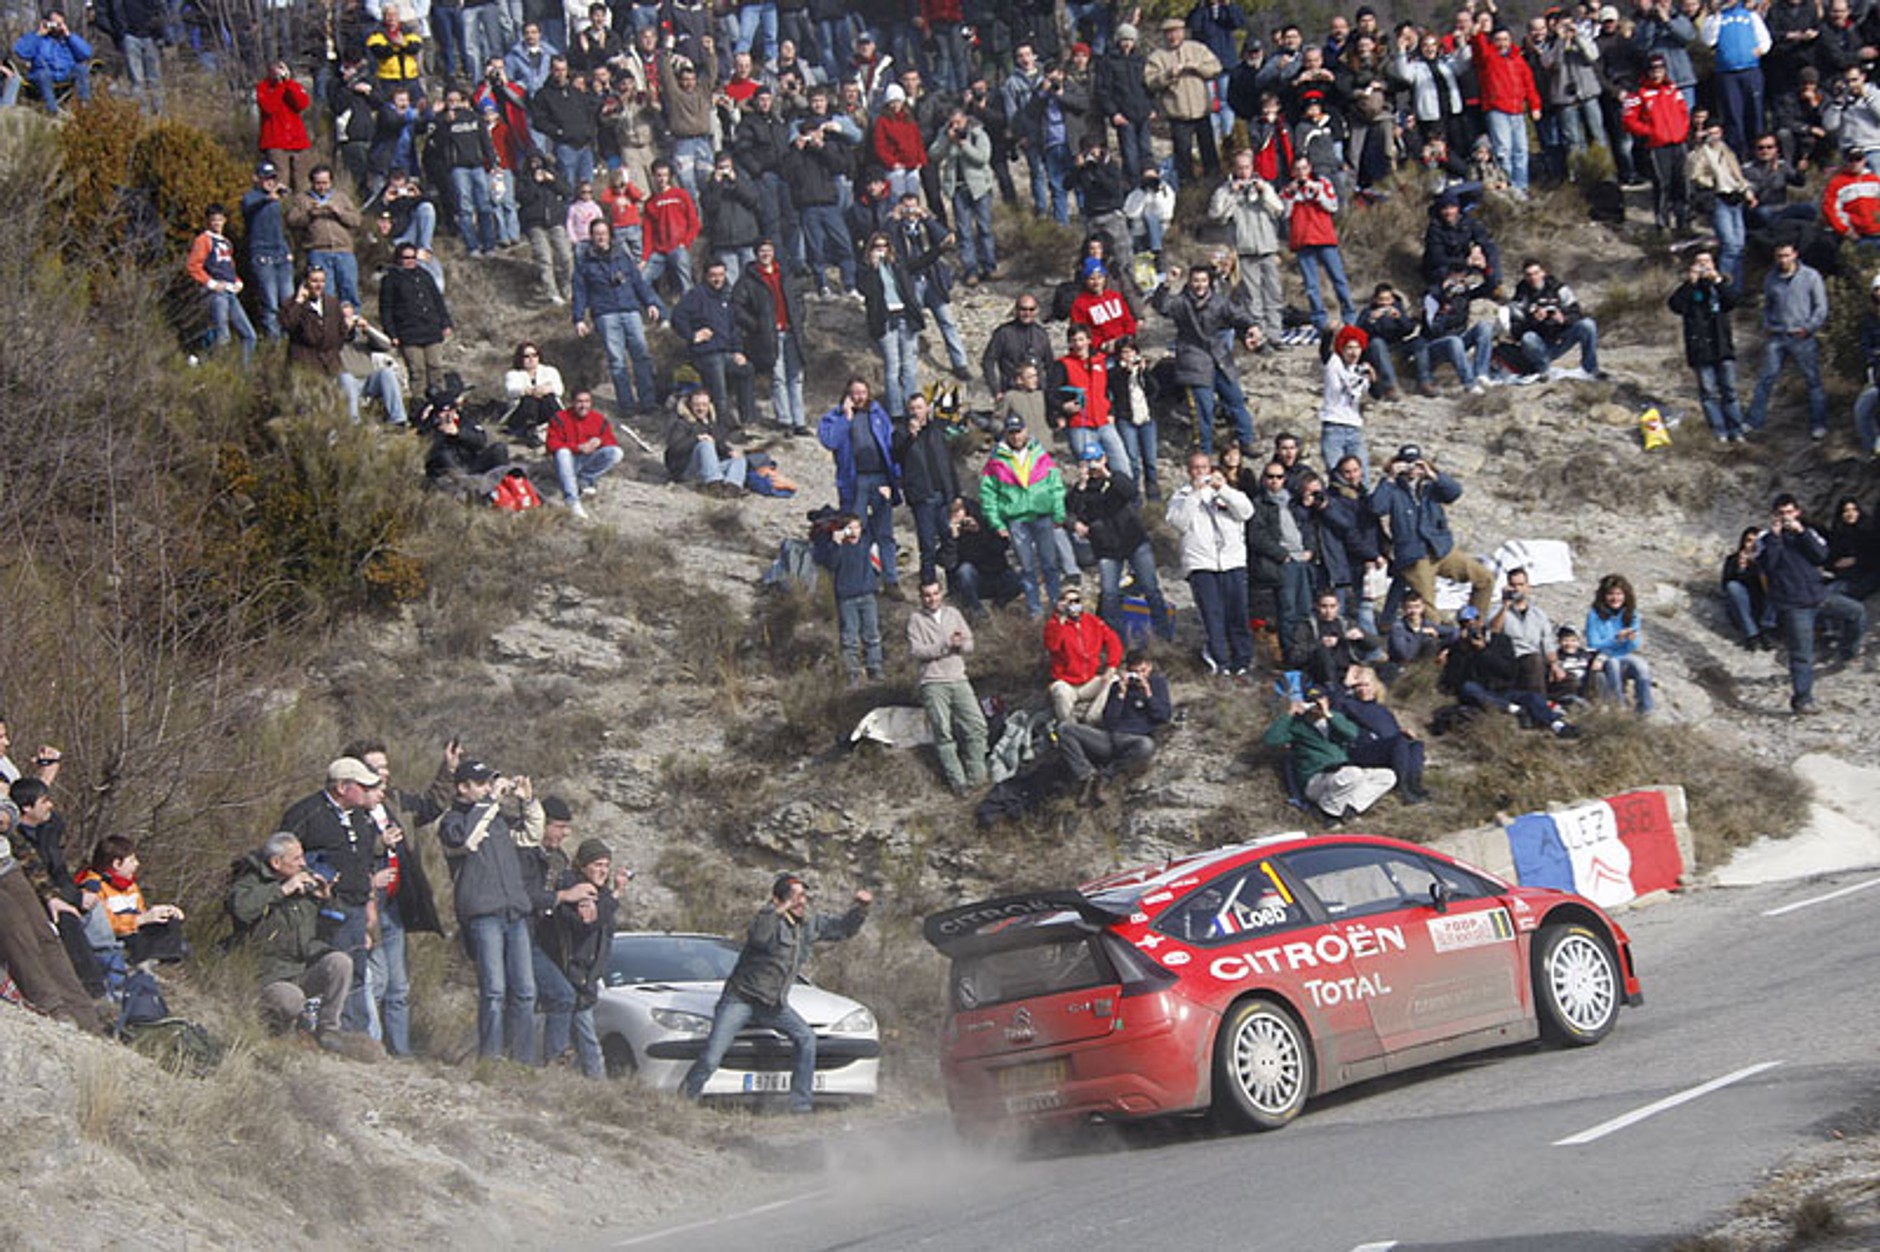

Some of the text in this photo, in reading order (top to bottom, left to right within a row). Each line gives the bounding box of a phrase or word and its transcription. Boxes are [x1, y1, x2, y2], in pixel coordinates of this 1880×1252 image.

[1235, 905, 1287, 930] Loeb
[1209, 924, 1407, 981] CITROËN
[1304, 972, 1392, 1008] TOTAL
